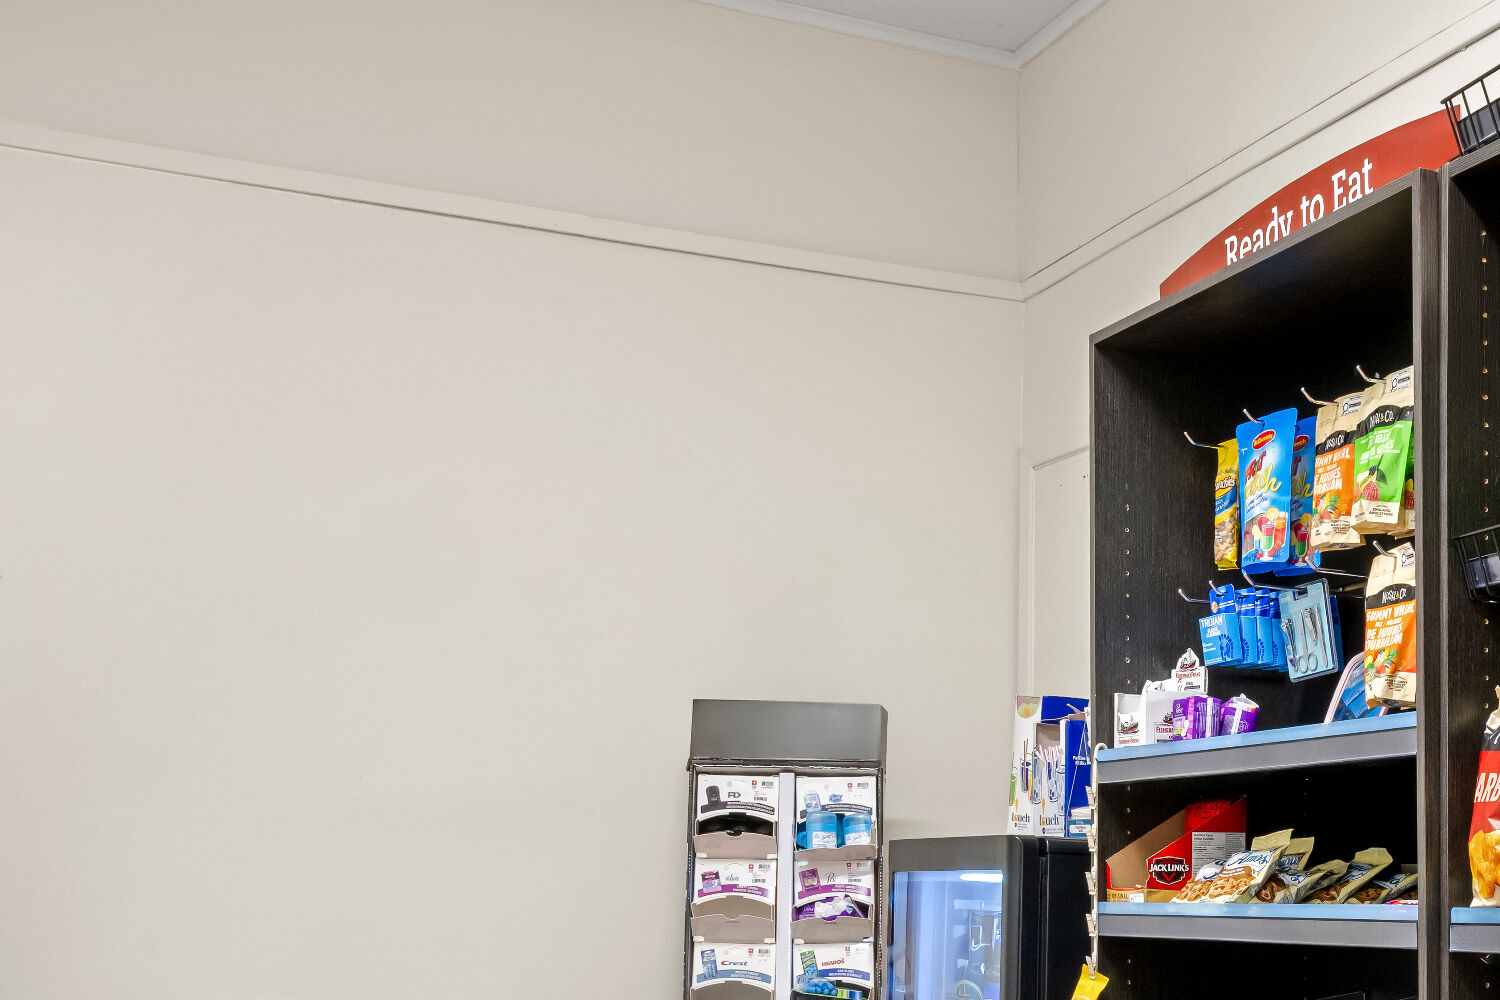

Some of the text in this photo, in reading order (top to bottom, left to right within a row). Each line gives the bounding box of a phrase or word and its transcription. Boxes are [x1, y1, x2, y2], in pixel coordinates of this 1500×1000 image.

[1300, 190, 1324, 228] to
[1331, 158, 1373, 211] Eat
[1201, 615, 1223, 628] TROJAN
[1012, 813, 1031, 824] touch
[1040, 813, 1060, 826] touch
[1149, 863, 1168, 873] JACK
